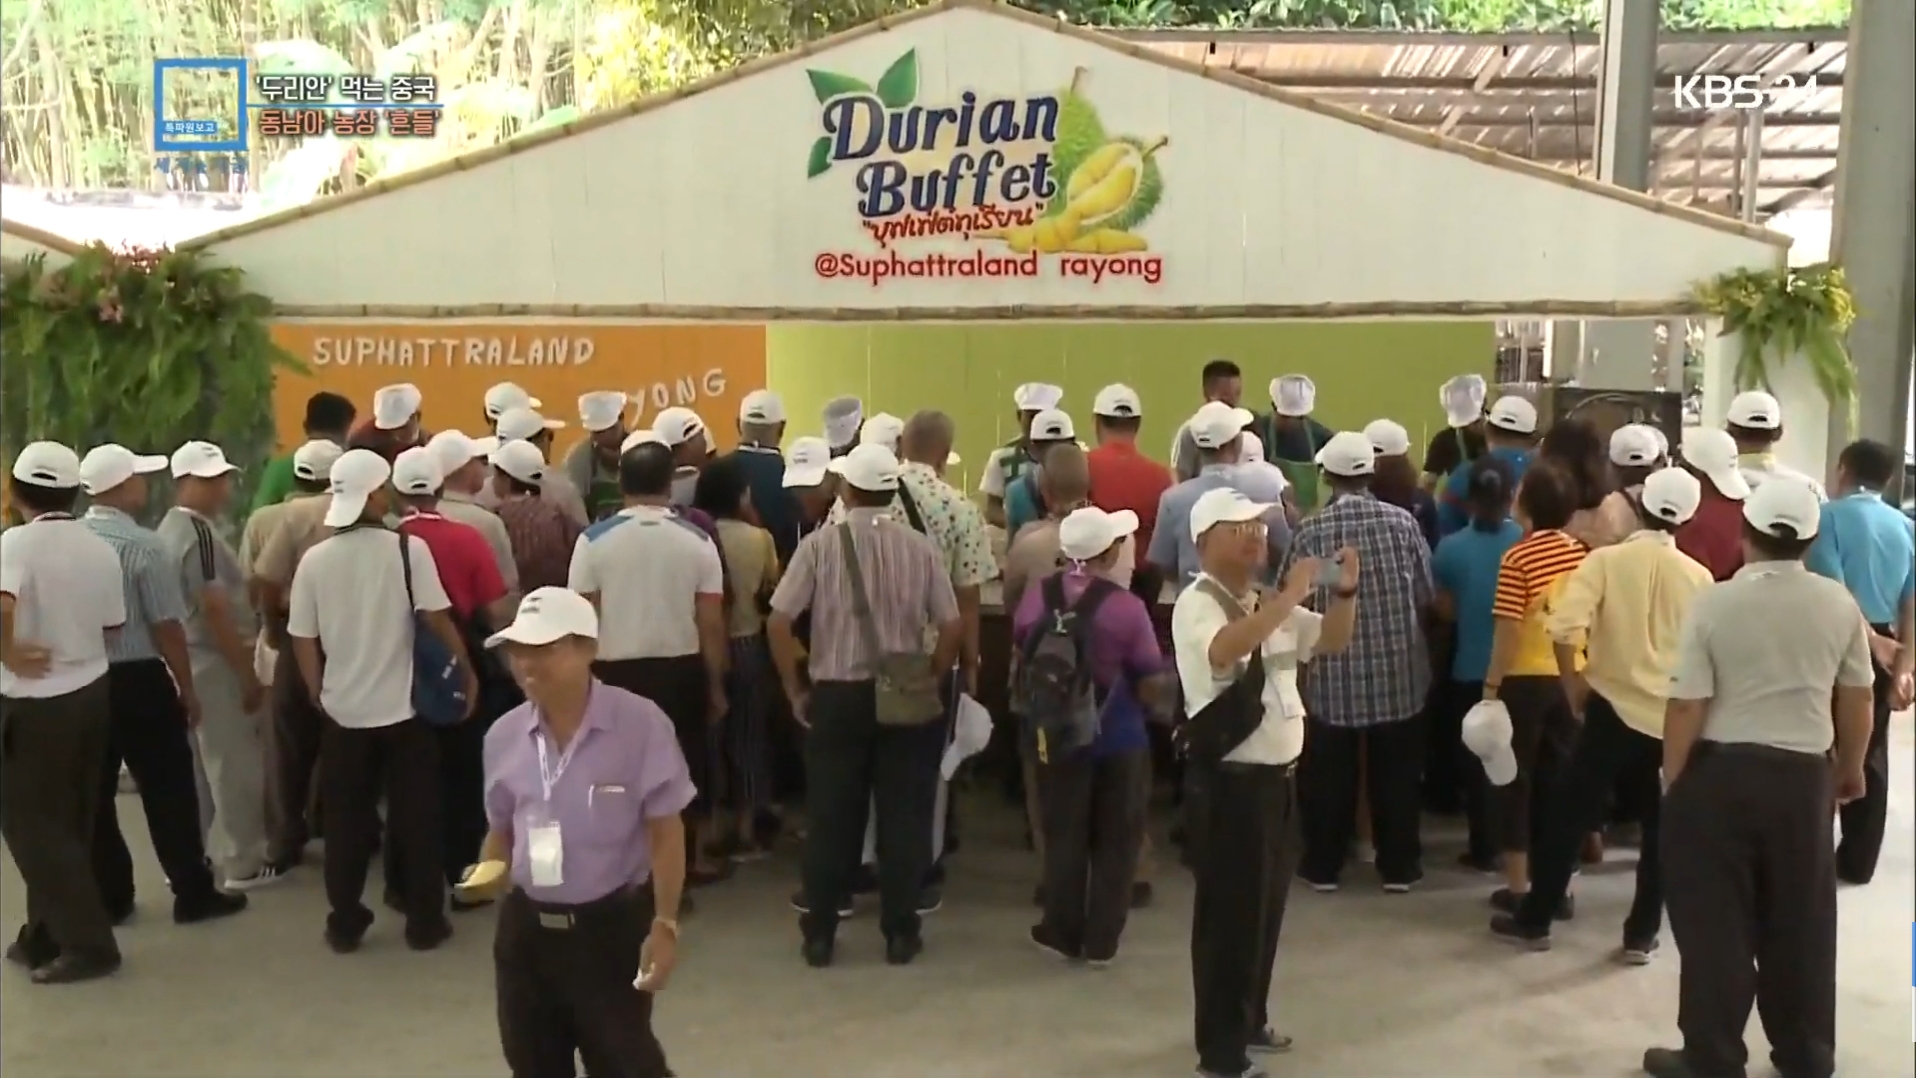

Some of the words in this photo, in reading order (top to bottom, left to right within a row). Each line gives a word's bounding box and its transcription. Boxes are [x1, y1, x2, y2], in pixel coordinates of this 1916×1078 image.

[823, 91, 1060, 161] Durian
[856, 149, 1056, 217] Buffet
[815, 250, 1038, 286] @Suphattraland
[1060, 255, 1162, 283] rayong
[313, 336, 595, 367] SUPHATTRALAND
